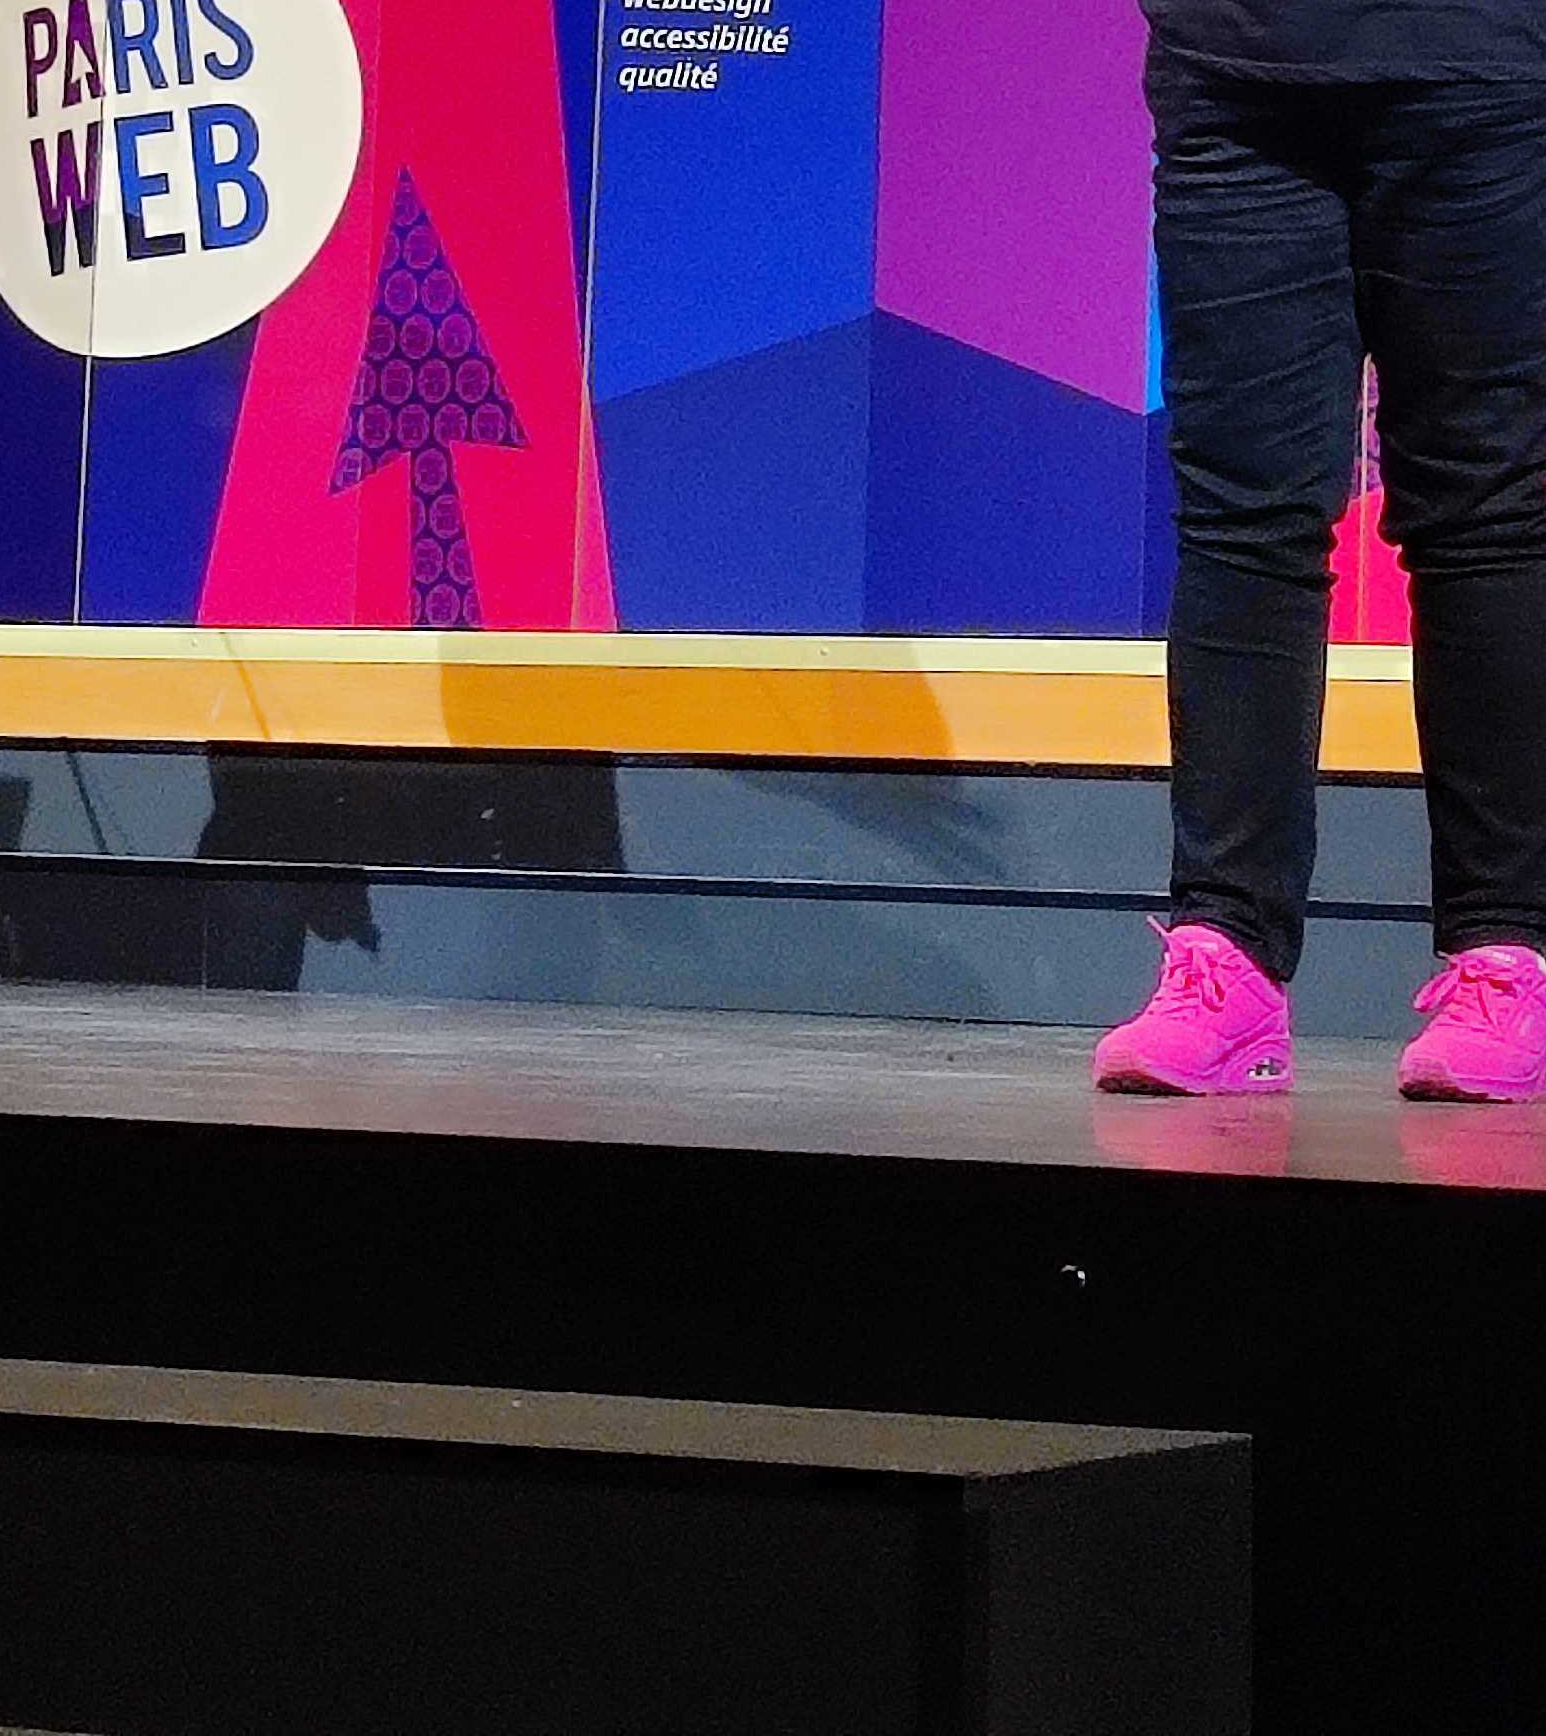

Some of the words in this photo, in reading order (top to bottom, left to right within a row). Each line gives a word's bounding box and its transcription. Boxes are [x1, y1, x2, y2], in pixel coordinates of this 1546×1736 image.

[620, 24, 790, 54] accessibilité
[618, 61, 718, 92] qualité
[30, 102, 270, 277] WEB
